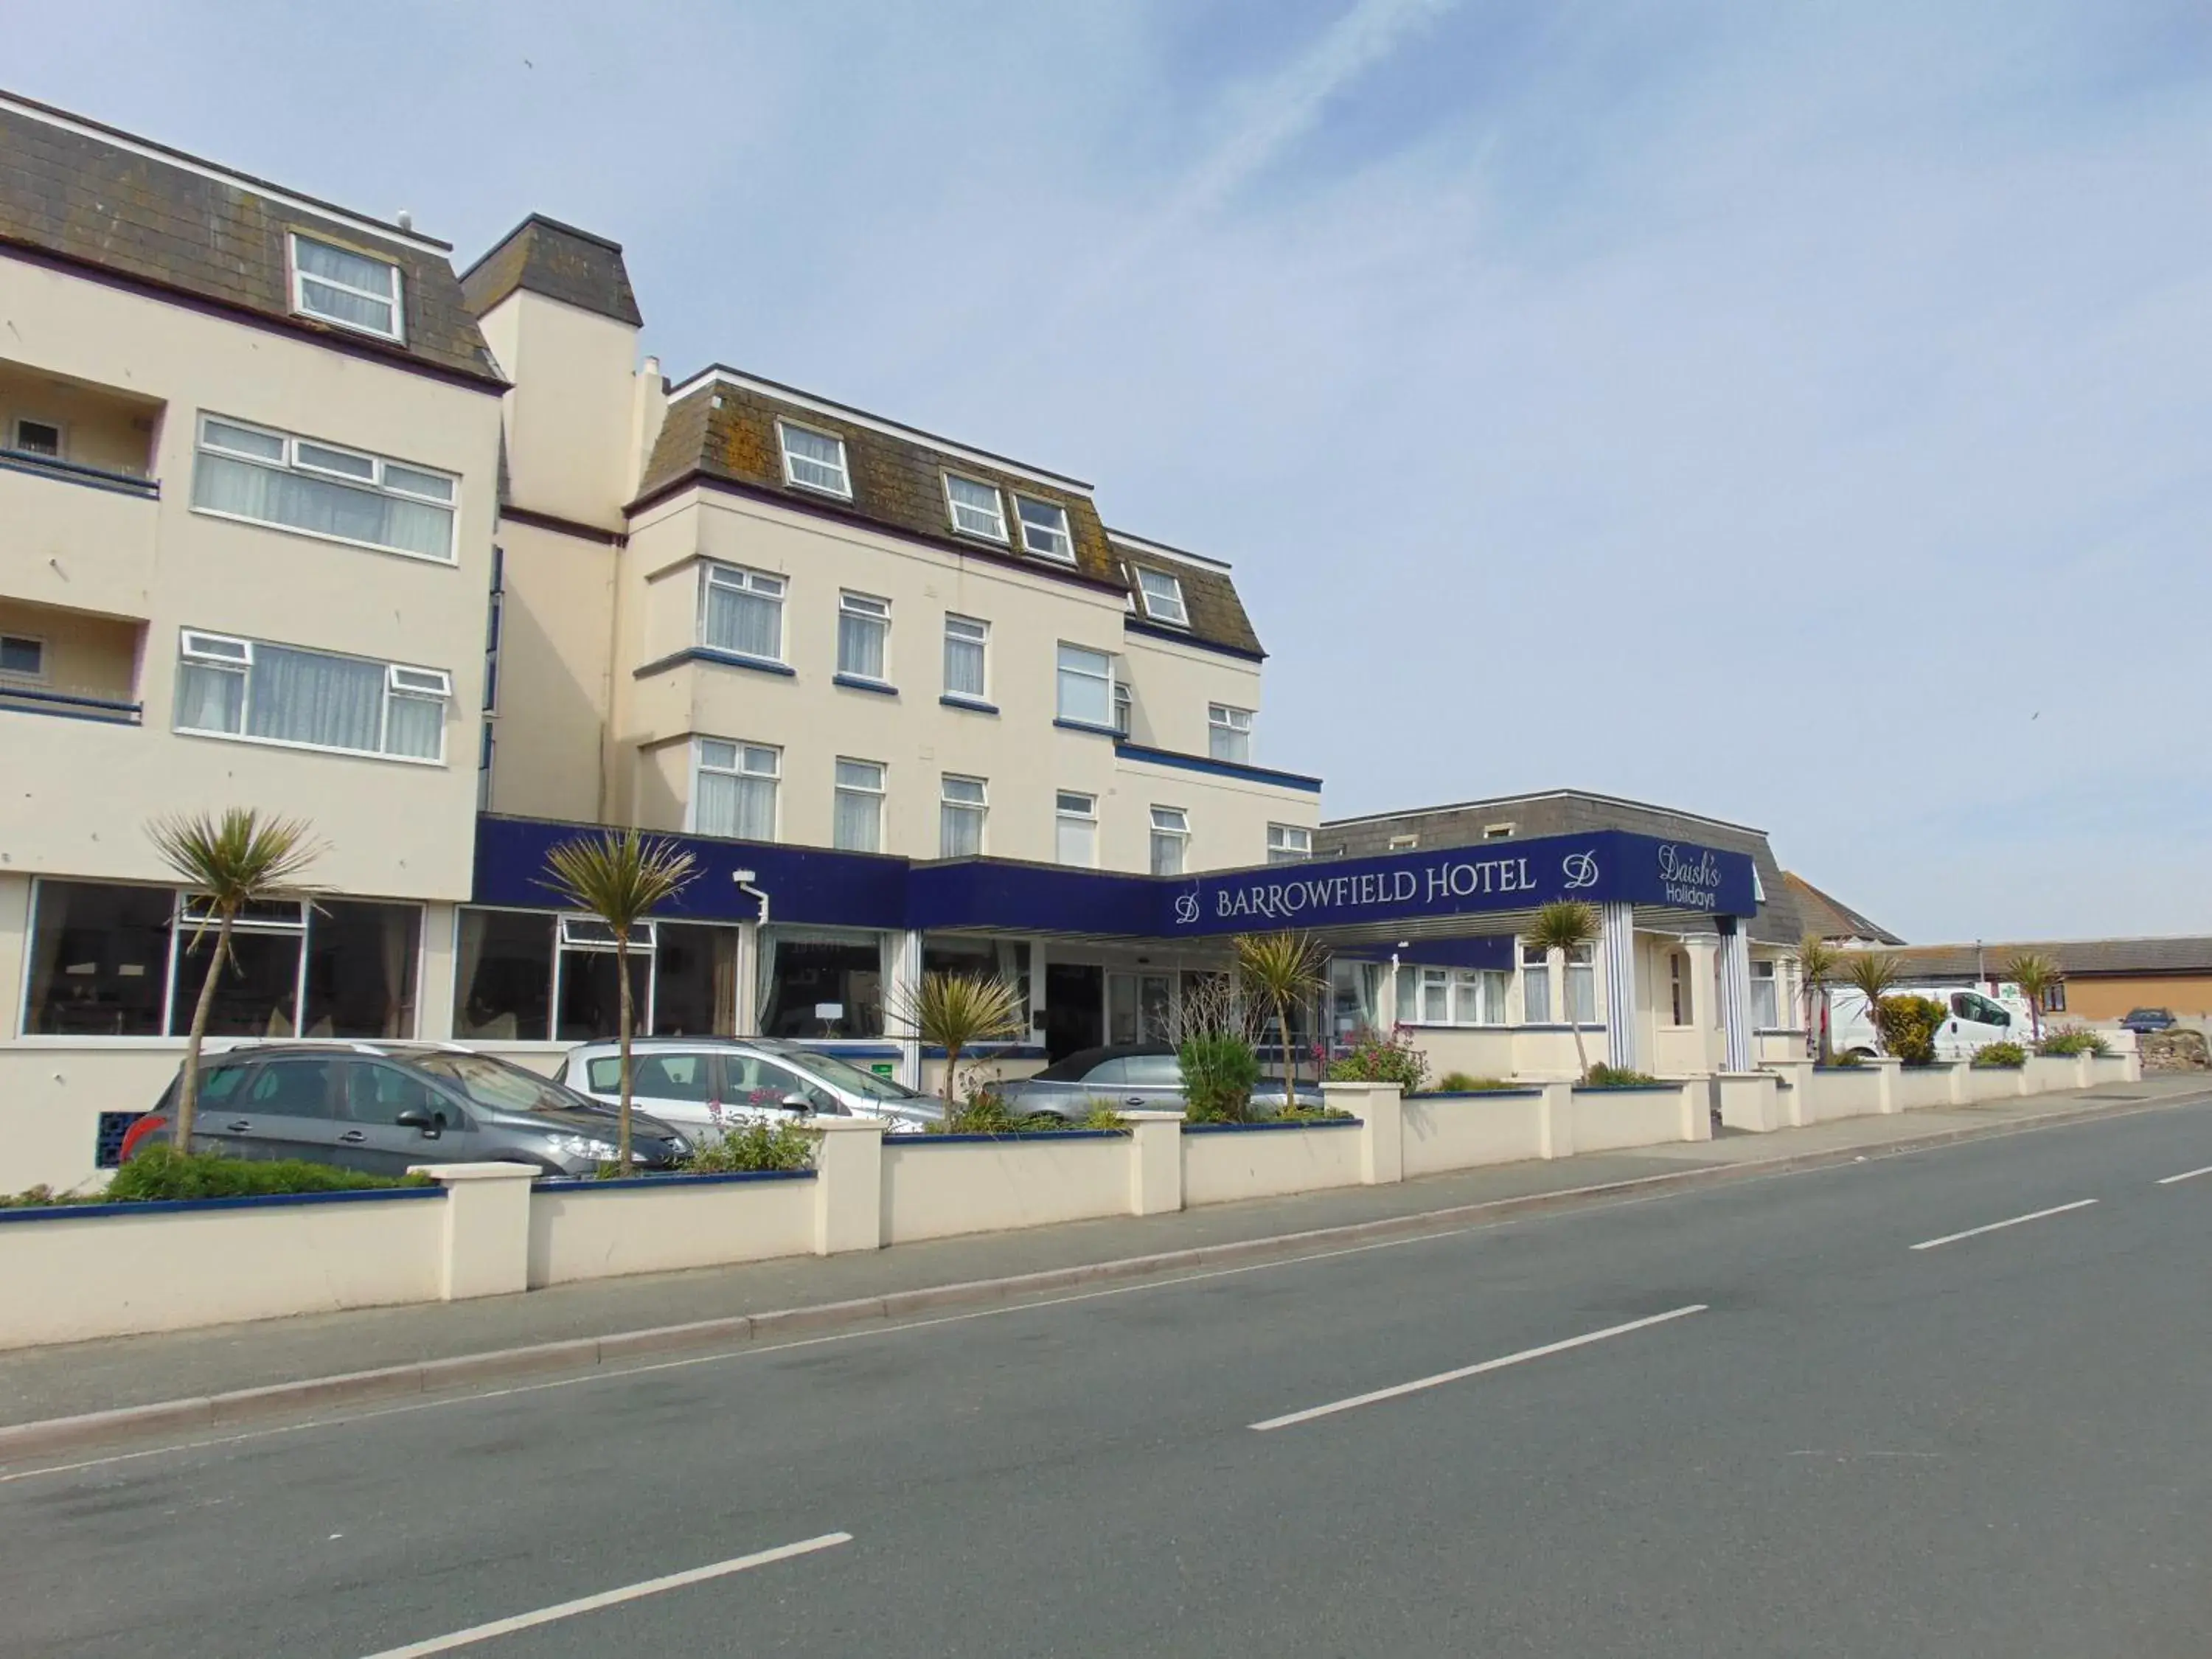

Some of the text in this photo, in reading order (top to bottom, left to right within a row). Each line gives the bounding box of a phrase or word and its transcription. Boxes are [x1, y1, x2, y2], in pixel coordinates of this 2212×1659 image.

[1658, 844, 1722, 887] Daish's
[1217, 871, 1416, 917] BARROWFIELD
[1426, 858, 1537, 903] HOTEL
[1666, 882, 1716, 911] Holidays
